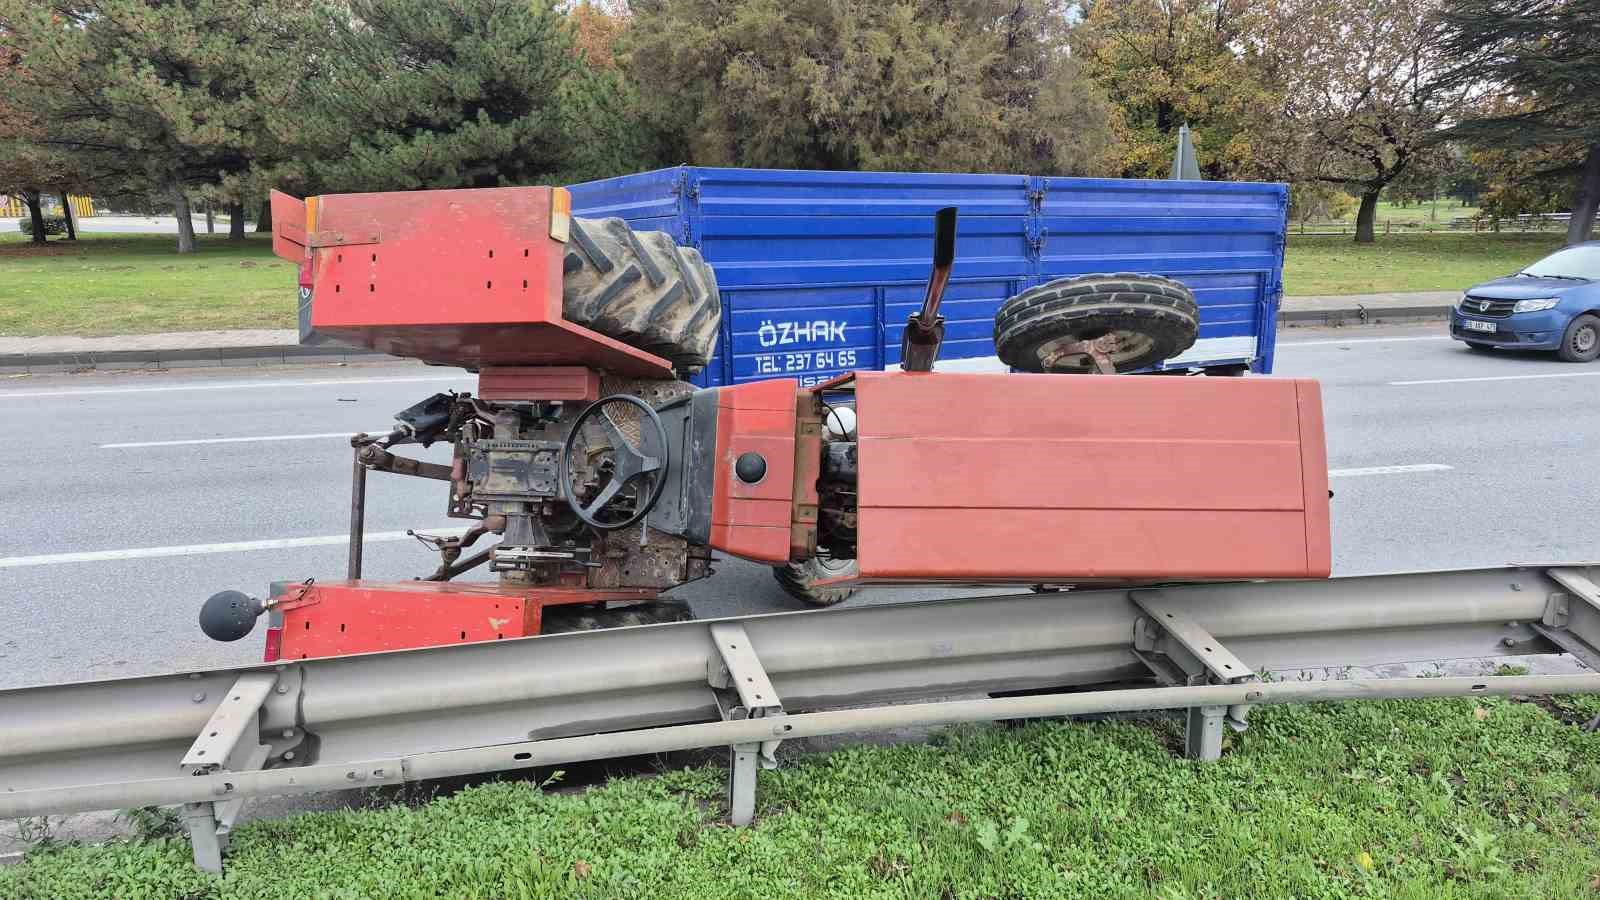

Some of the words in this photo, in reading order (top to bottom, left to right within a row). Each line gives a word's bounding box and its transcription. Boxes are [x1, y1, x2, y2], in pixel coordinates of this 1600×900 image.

[759, 320, 847, 346] ÖZHAK
[786, 353, 811, 371] 237
[816, 351, 834, 368] 64
[838, 350, 856, 367] 65
